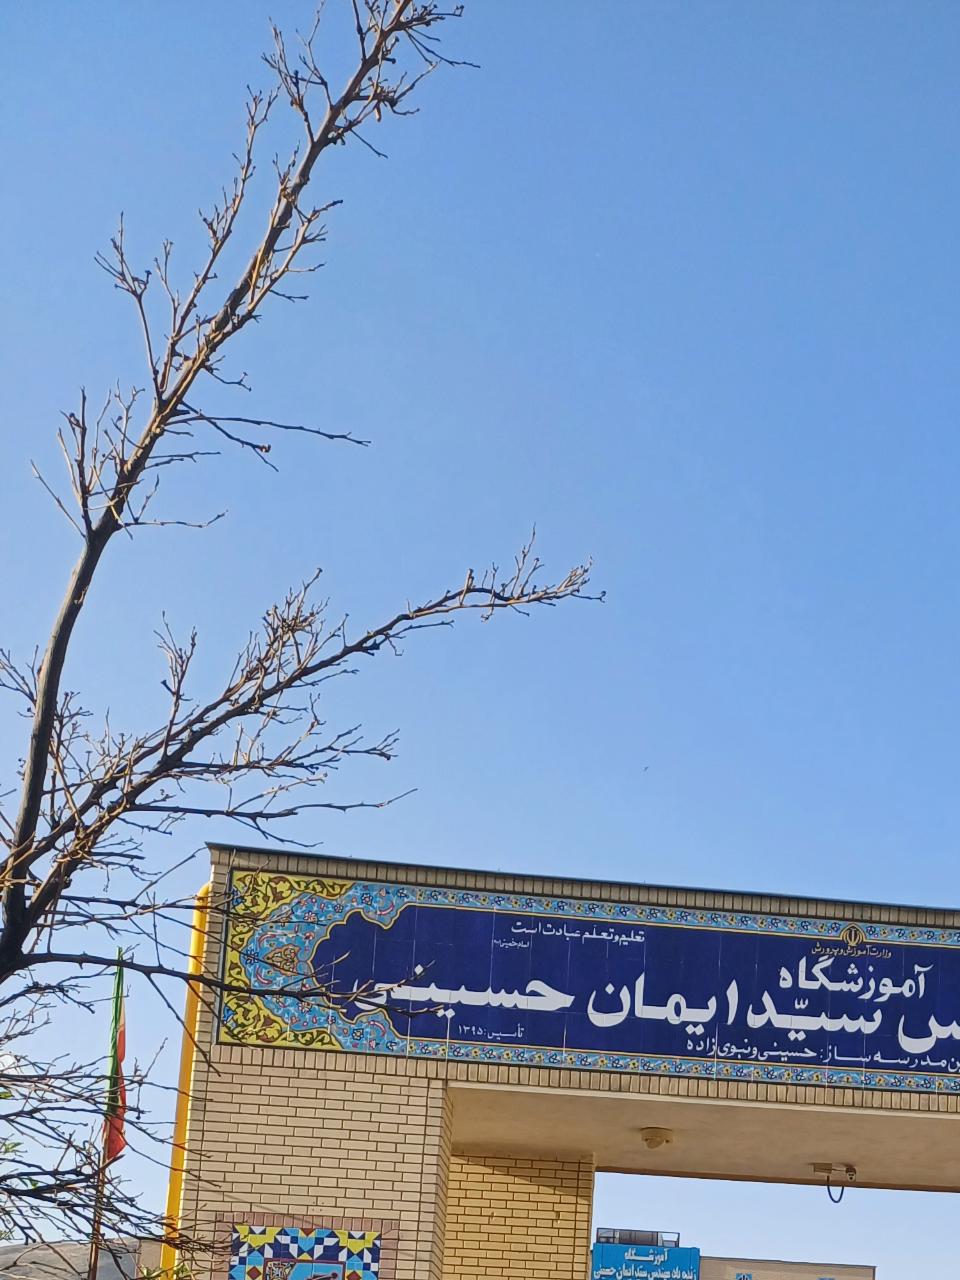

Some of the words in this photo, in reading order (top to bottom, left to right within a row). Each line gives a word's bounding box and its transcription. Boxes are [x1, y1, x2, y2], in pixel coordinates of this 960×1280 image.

[511, 921, 541, 934] است
[543, 923, 580, 940] عبادت
[619, 930, 645, 946] تعلیم
[811, 941, 840, 956] پرورش
[844, 944, 870, 957] آموزش
[869, 947, 892, 958] وزارت
[779, 954, 934, 1003] آموزشگاه
[352, 963, 575, 1019] حسینی
[586, 971, 737, 1036] ایمان
[687, 1036, 717, 1056] زاده
[718, 1038, 751, 1059] نبوی
[758, 1042, 817, 1061] حسینی
[874, 1050, 947, 1068] مدرسه
[624, 1247, 669, 1265] آموزشگاه
